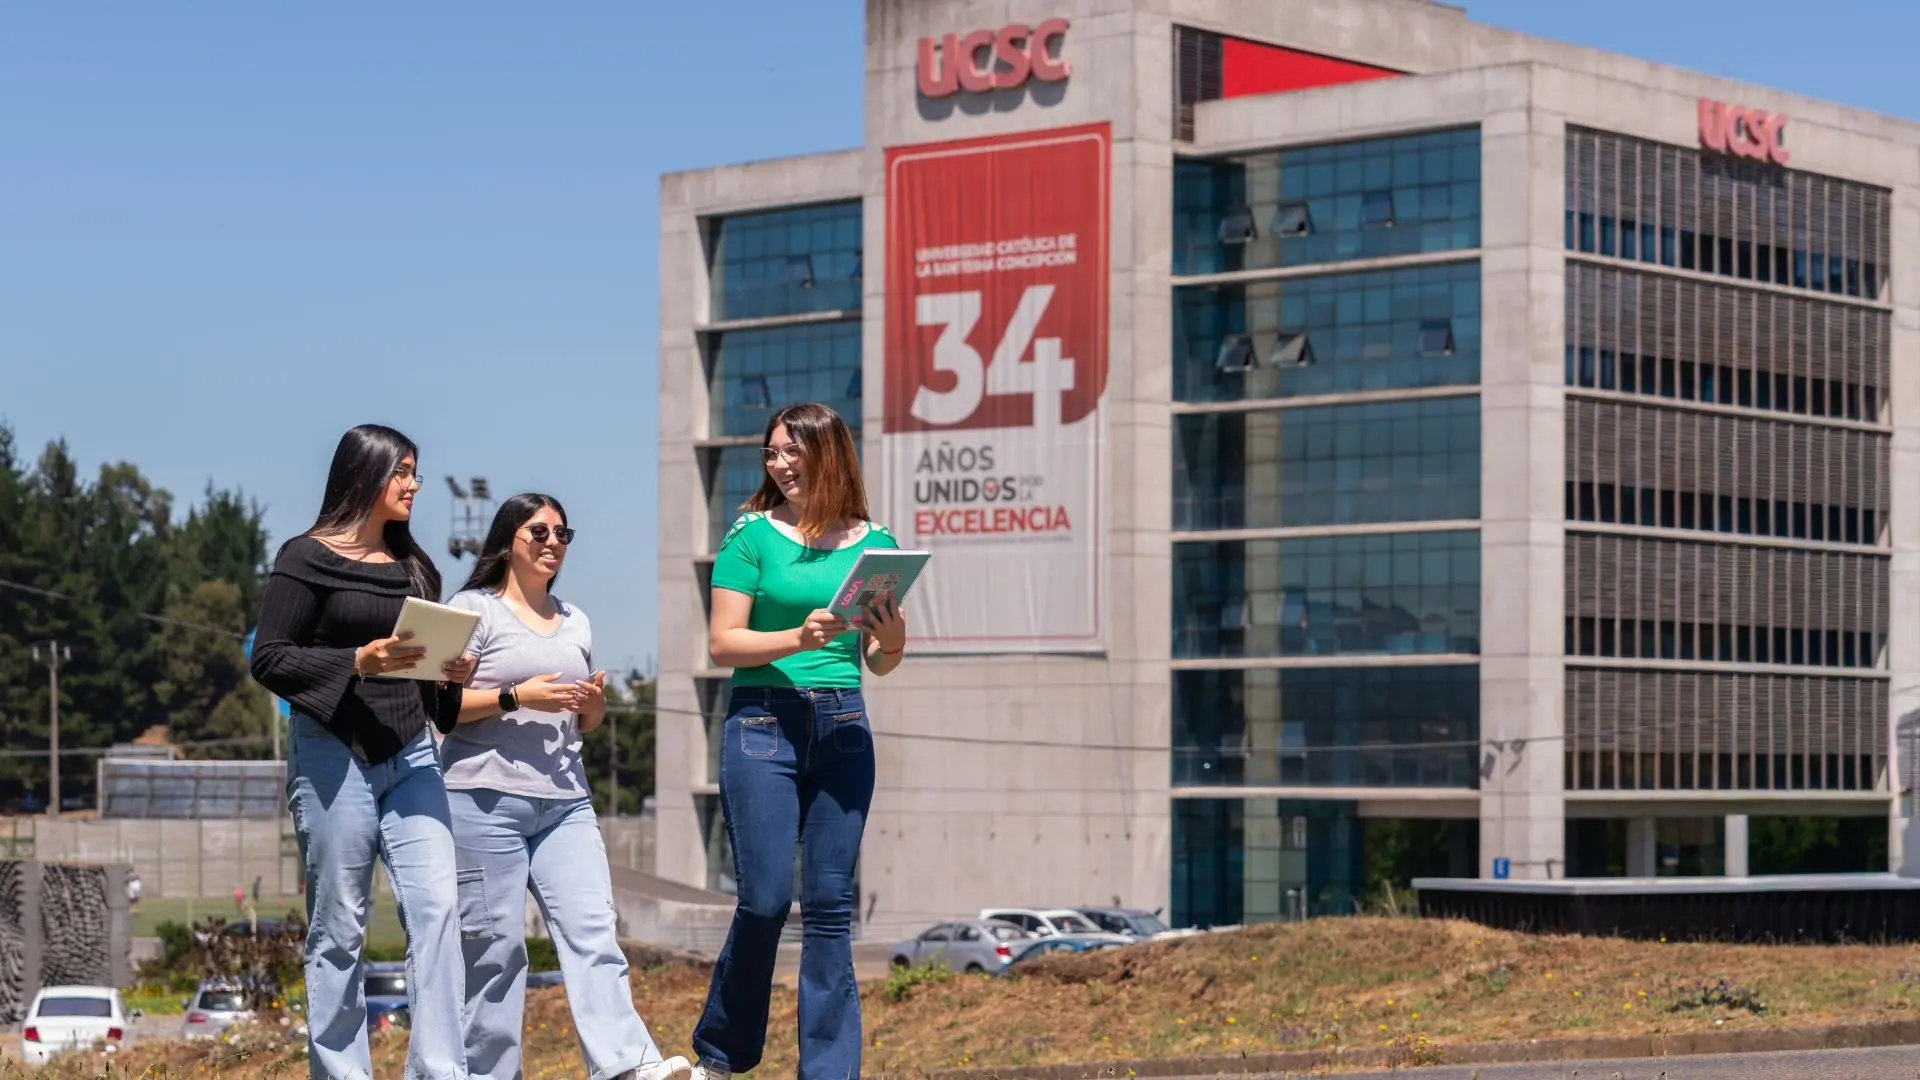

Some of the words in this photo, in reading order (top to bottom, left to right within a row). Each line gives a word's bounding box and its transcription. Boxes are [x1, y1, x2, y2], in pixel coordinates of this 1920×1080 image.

[917, 18, 1071, 97] UCSC
[1697, 97, 1789, 164] UCSC
[910, 284, 1075, 427] 34
[916, 441, 994, 473] AÑOS
[914, 477, 1016, 504] UNIDOS
[914, 505, 1071, 535] EXCELENCIA
